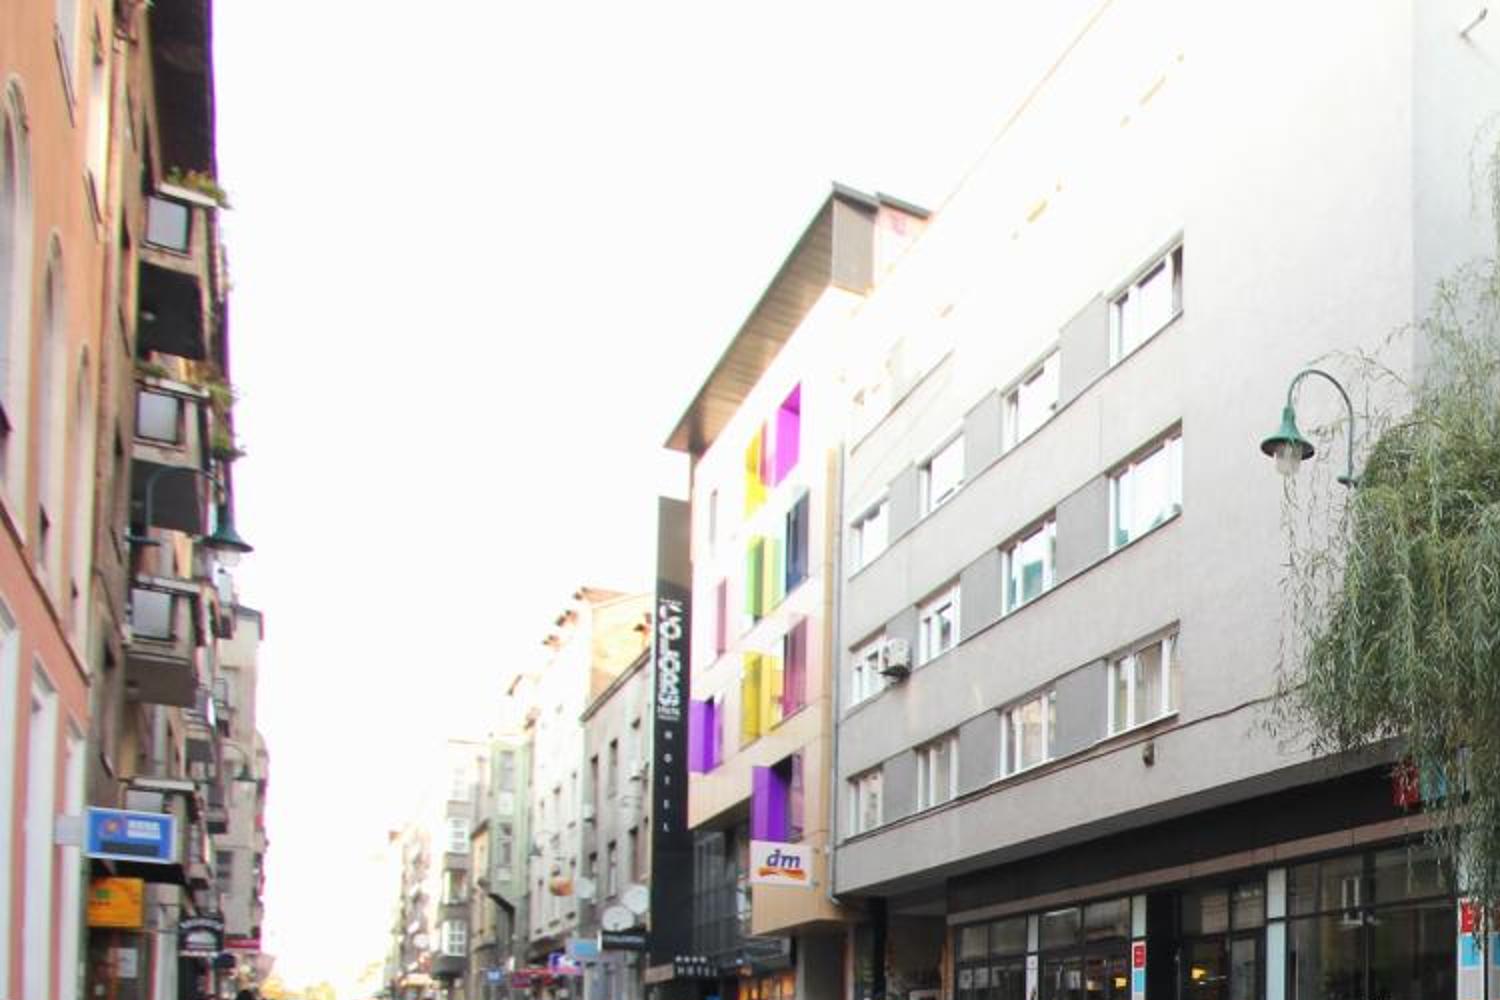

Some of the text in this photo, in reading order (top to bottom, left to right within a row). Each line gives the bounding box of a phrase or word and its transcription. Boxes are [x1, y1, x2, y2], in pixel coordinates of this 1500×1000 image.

[663, 730, 673, 832] HOTEL
[767, 849, 801, 868] dm
[677, 965, 718, 977] HOTEL
